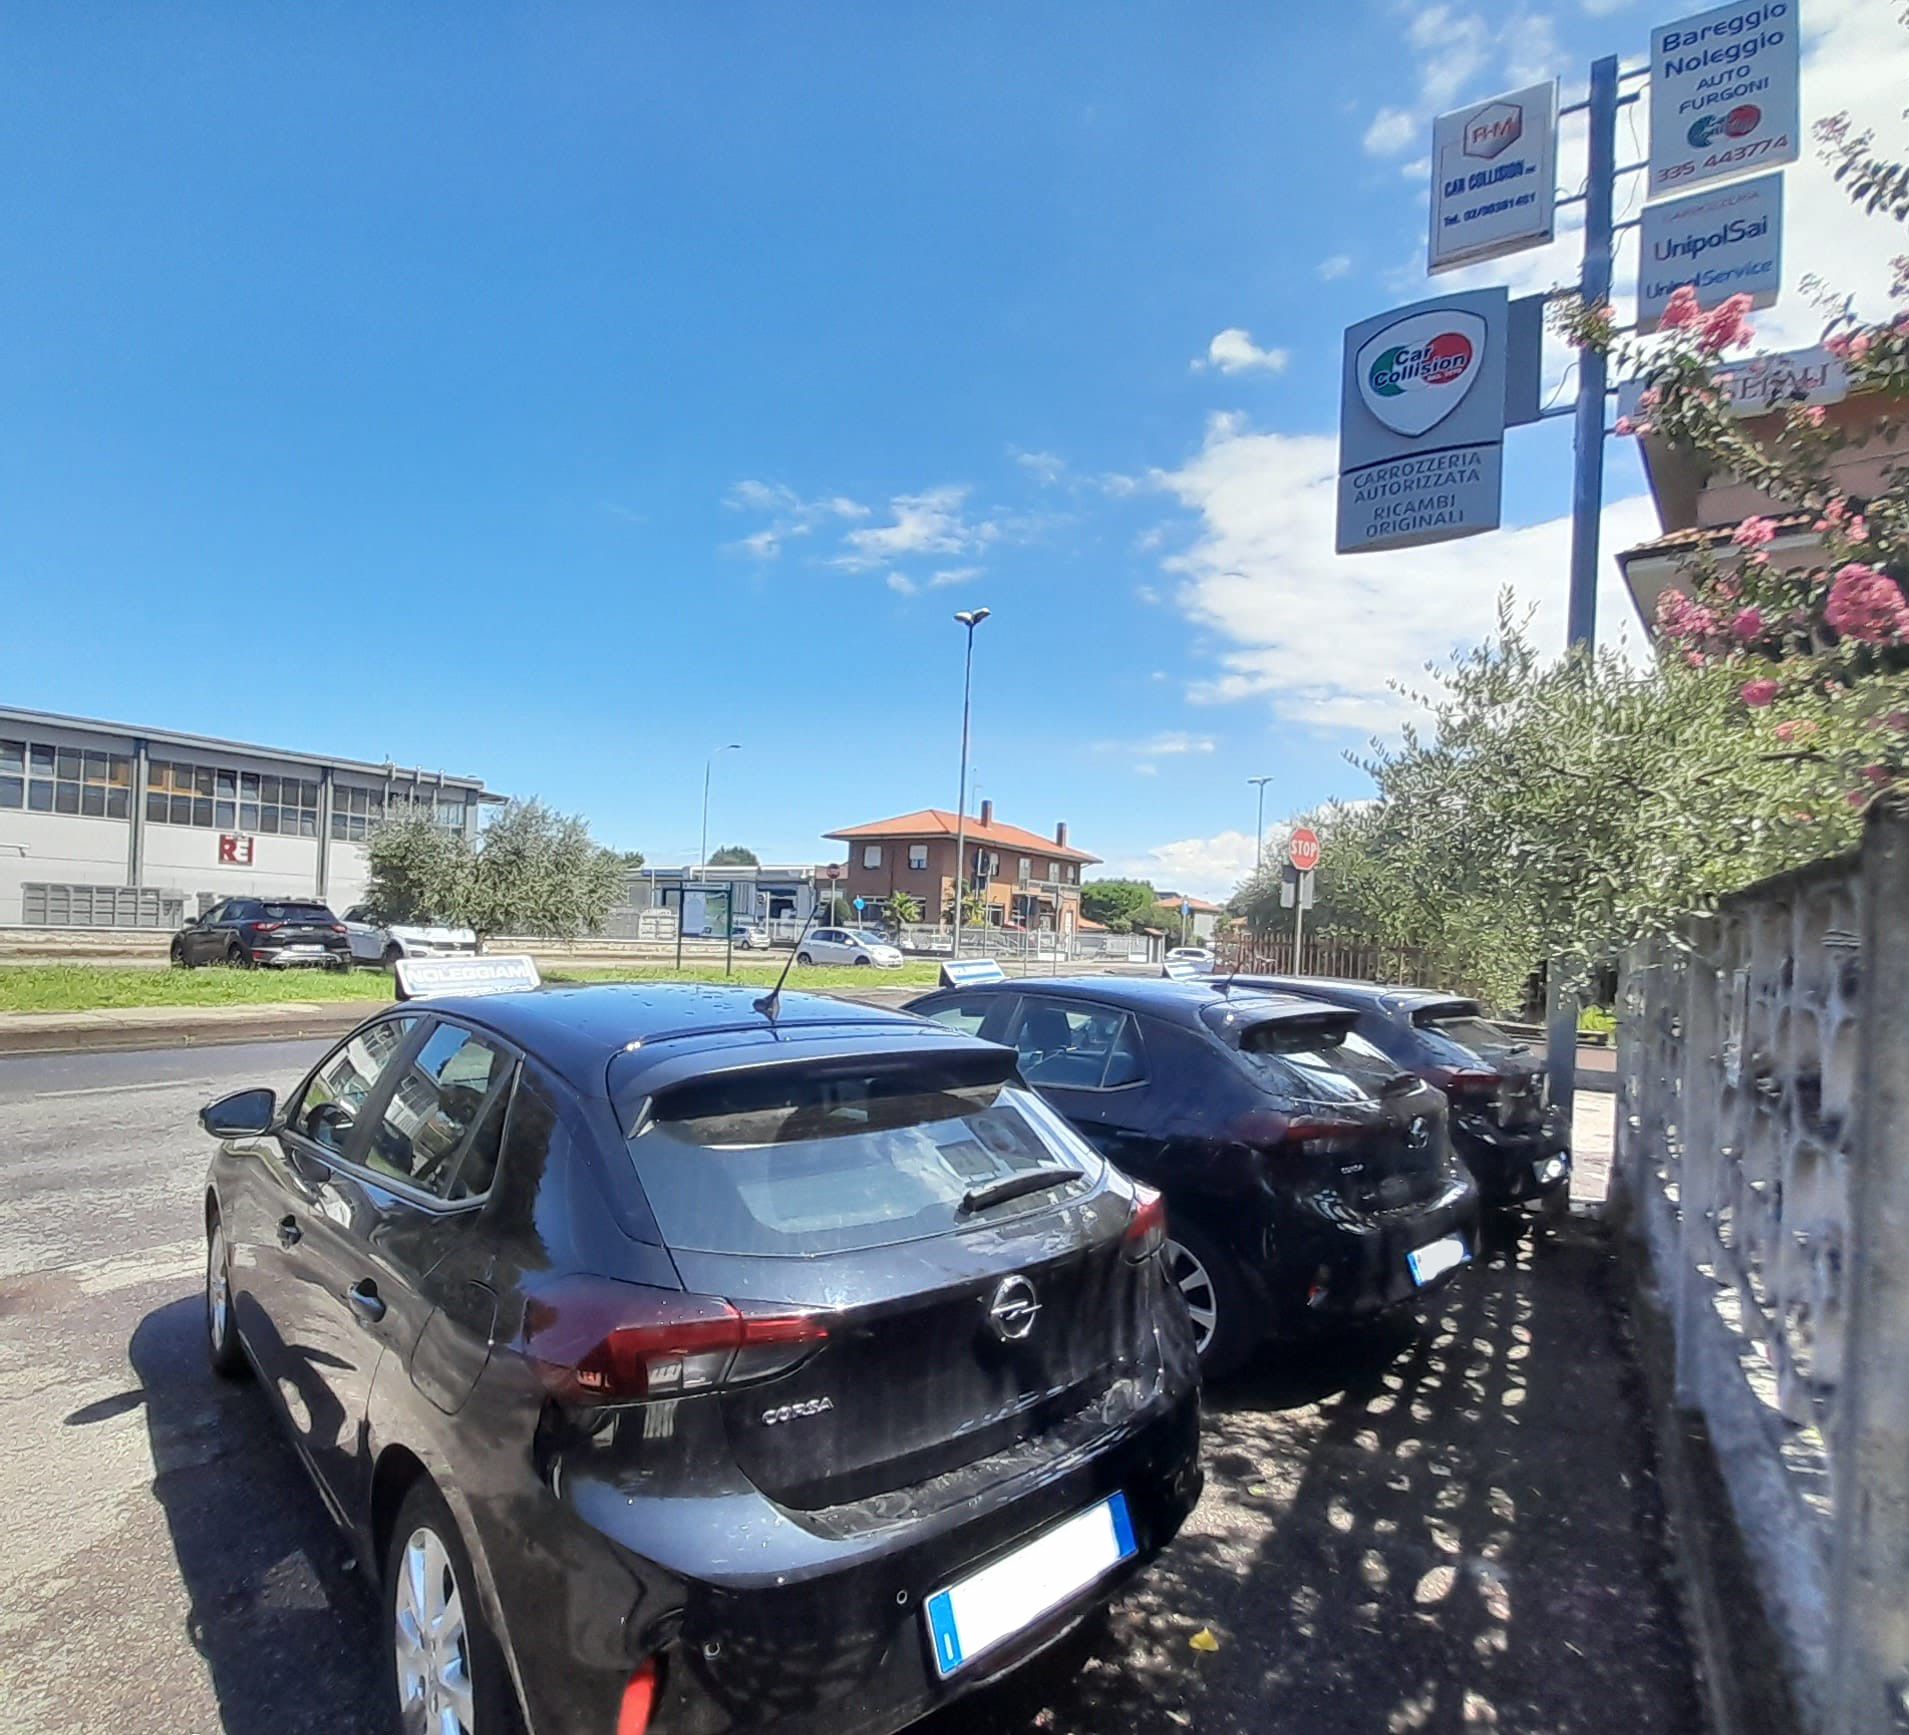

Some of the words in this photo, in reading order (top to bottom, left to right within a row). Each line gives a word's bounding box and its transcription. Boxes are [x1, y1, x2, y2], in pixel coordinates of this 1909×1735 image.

[1662, 3, 1787, 53] Bareggio
[1665, 31, 1785, 79] Noleggio
[1696, 65, 1751, 91] AUTO
[1679, 77, 1769, 114] FURGONI
[1658, 161, 1696, 183] 335
[1703, 135, 1788, 168] 443774
[1444, 177, 1466, 198] CAR
[1655, 215, 1768, 260] UnipolSai
[1374, 353, 1465, 387] Collision
[1395, 343, 1433, 366] Car
[1353, 451, 1482, 489] CARROZZERIA
[1354, 468, 1481, 504] AUTORIZZATA
[1366, 510, 1464, 538] ORIGINALI
[1374, 494, 1456, 521] RICAMBI
[1291, 839, 1317, 857] STOP
[762, 1396, 834, 1426] CORSA
